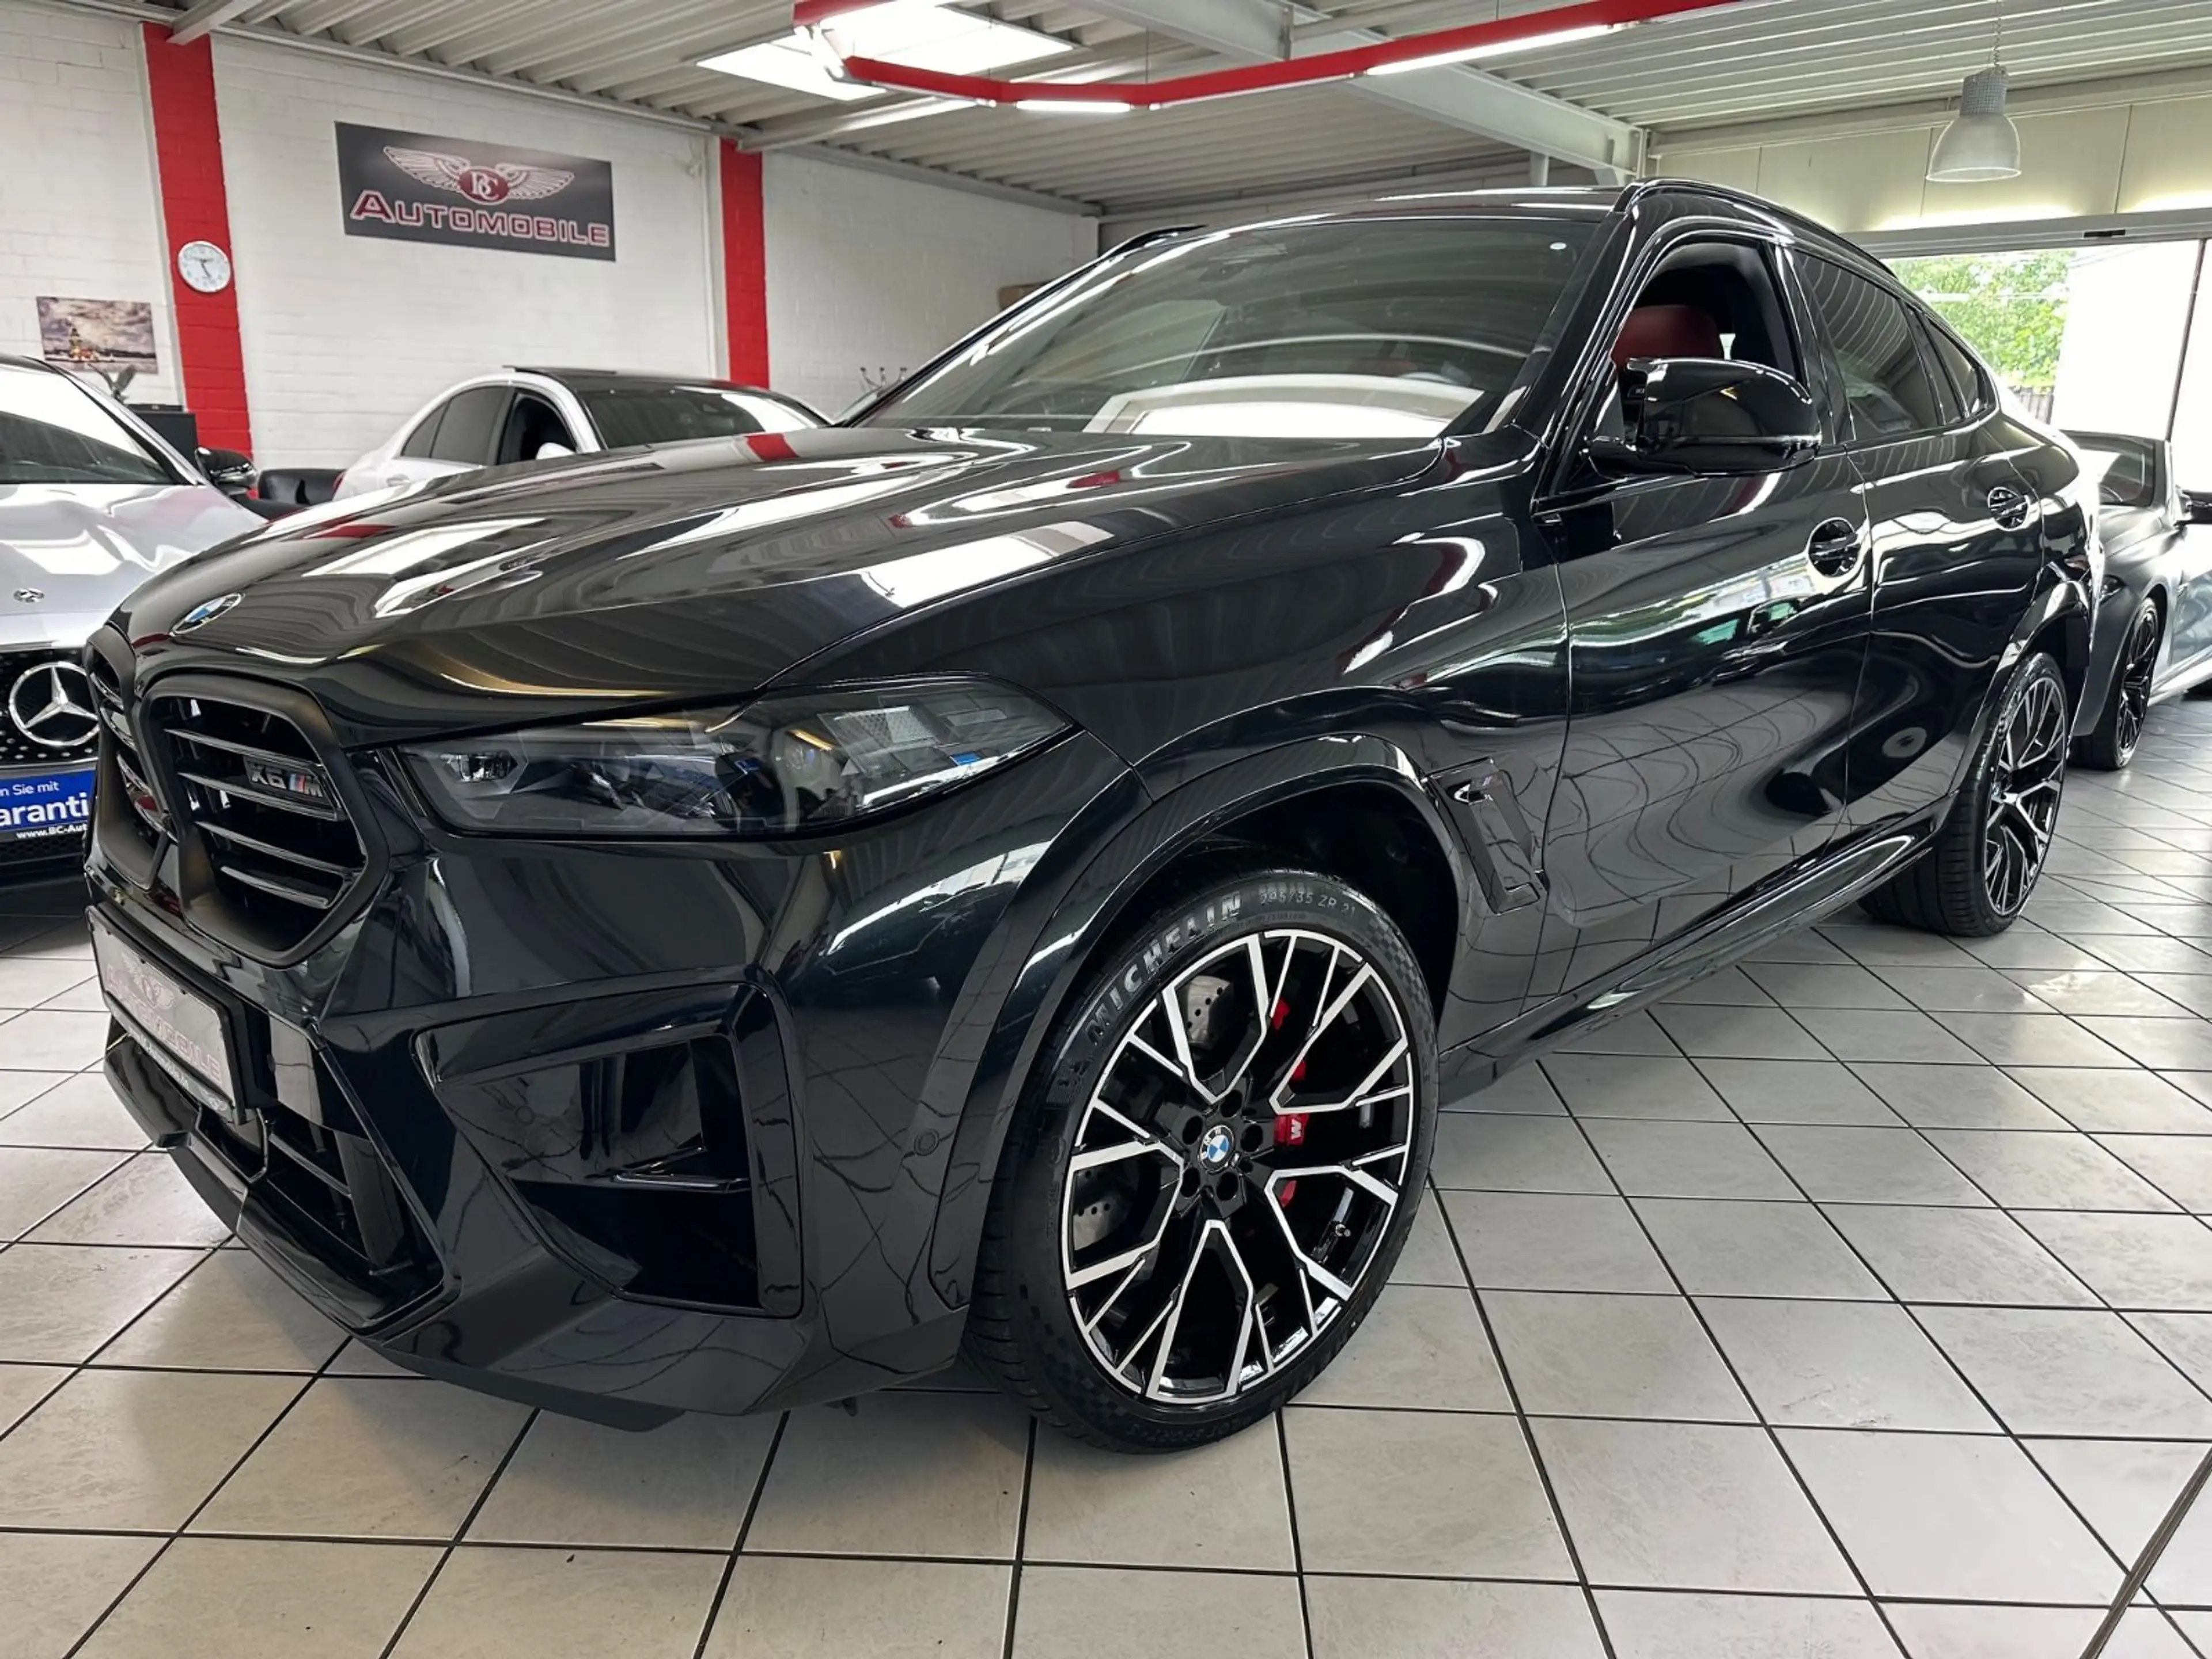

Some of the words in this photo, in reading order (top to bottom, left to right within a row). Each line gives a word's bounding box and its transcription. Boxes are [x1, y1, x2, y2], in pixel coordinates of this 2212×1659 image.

[471, 171, 499, 200] BC
[350, 190, 611, 247] AUTOMOBILE
[13, 783, 34, 796] Sie
[37, 781, 59, 793] mit
[1085, 891, 1241, 1044] MICHELIN
